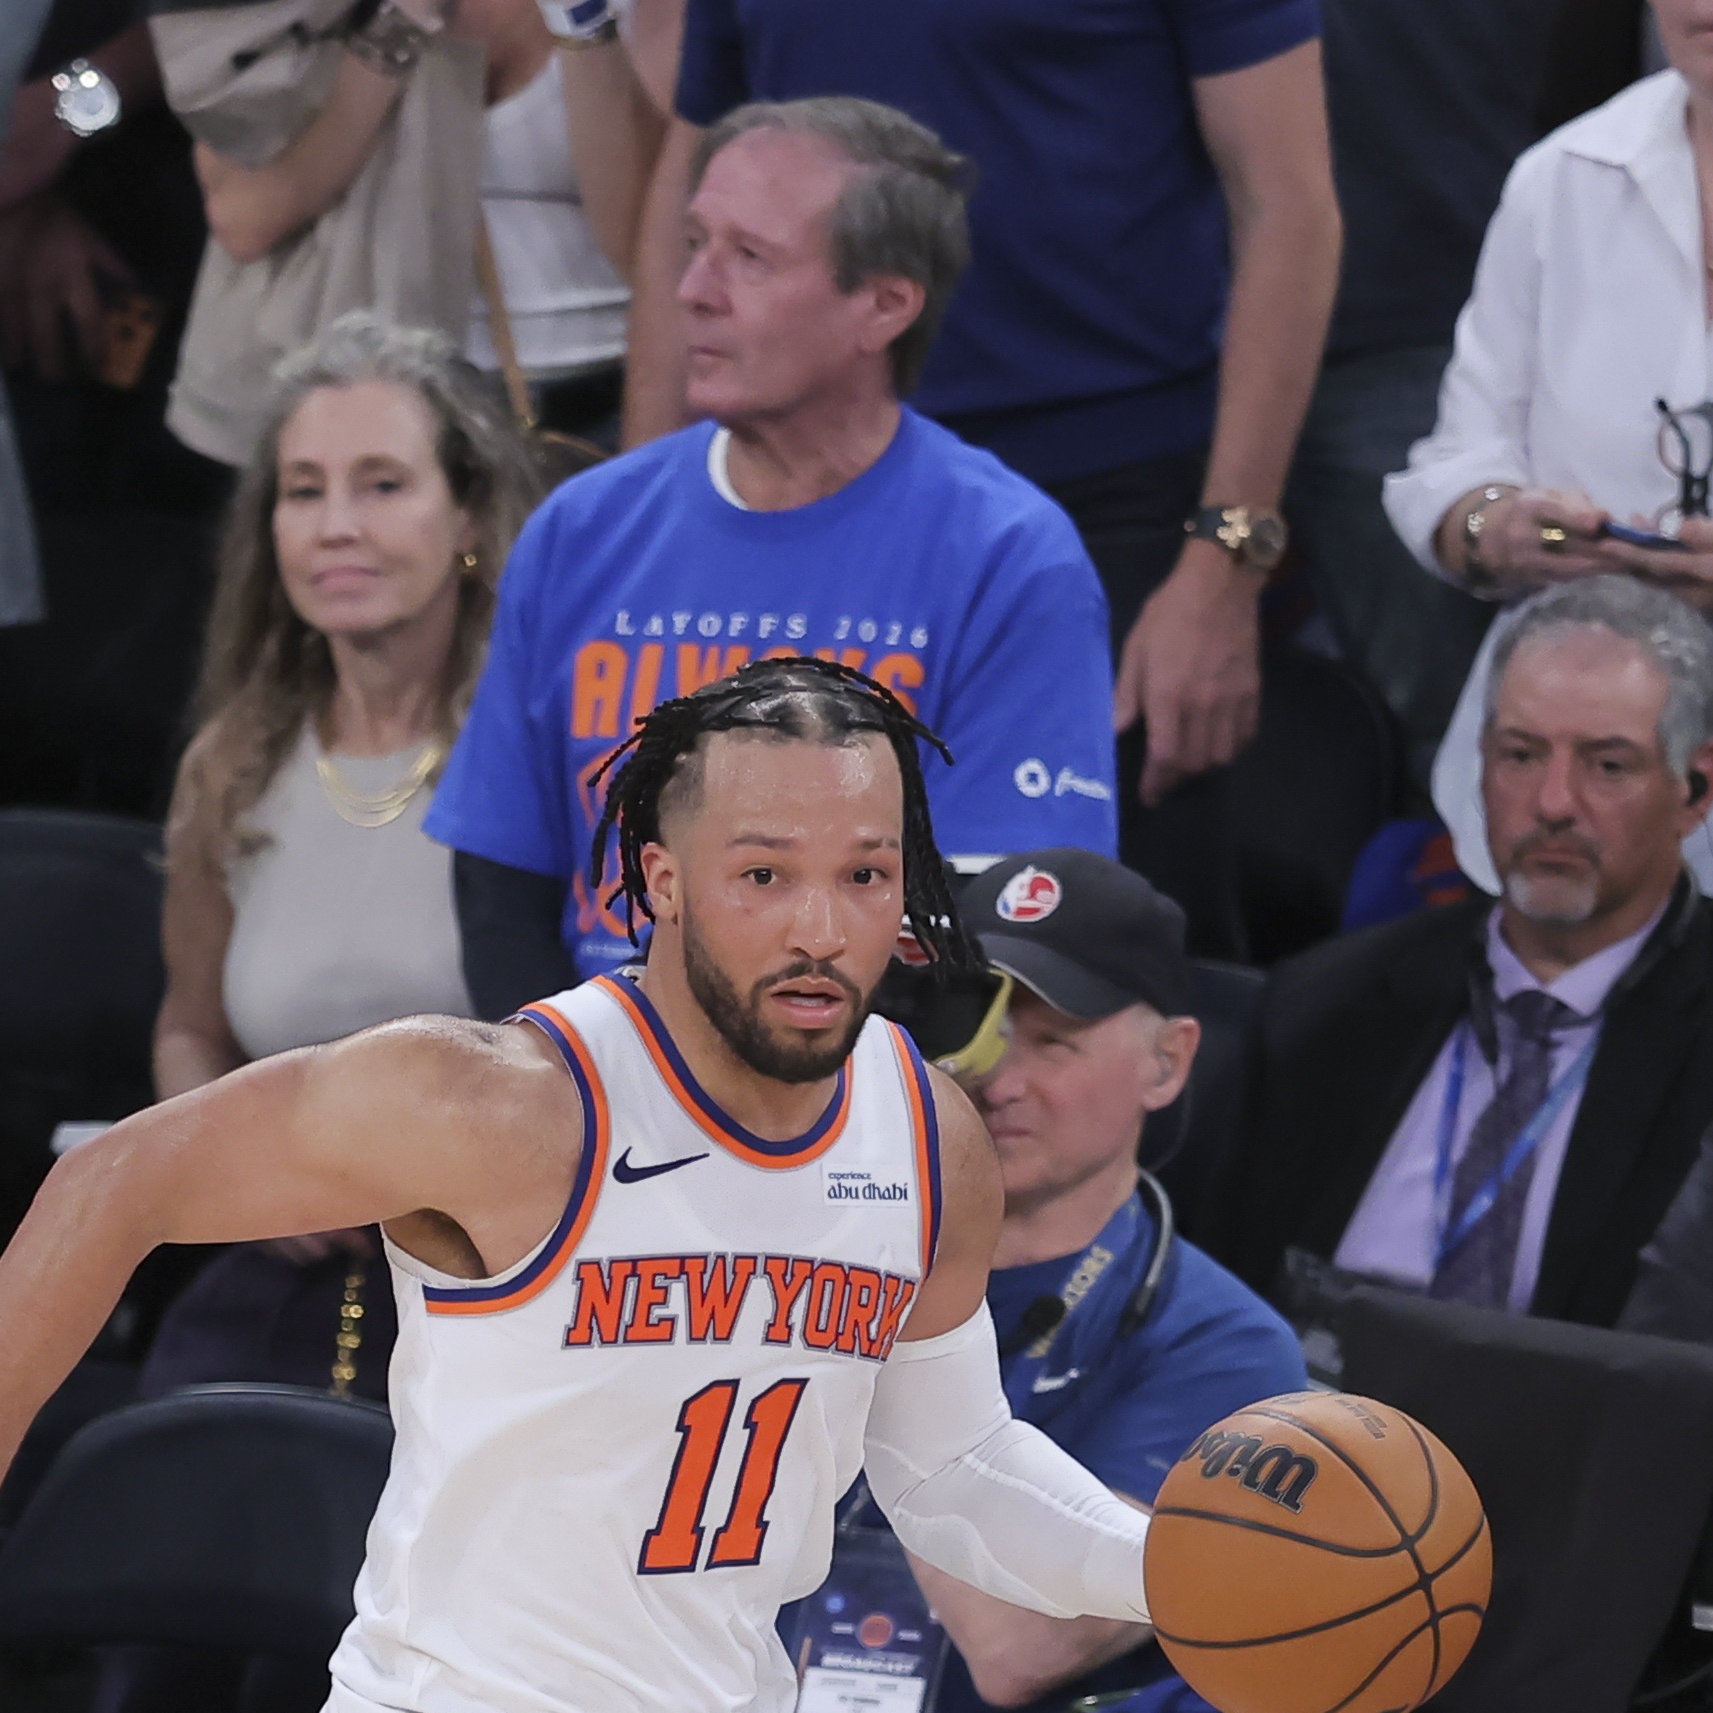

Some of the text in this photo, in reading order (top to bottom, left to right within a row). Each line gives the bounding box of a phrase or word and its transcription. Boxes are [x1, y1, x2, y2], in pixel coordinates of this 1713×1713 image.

[832, 614, 929, 649] 2026
[827, 1181, 909, 1202] abu dhabi
[561, 1252, 920, 1363] NEW YORK
[637, 1378, 811, 1576] 11
